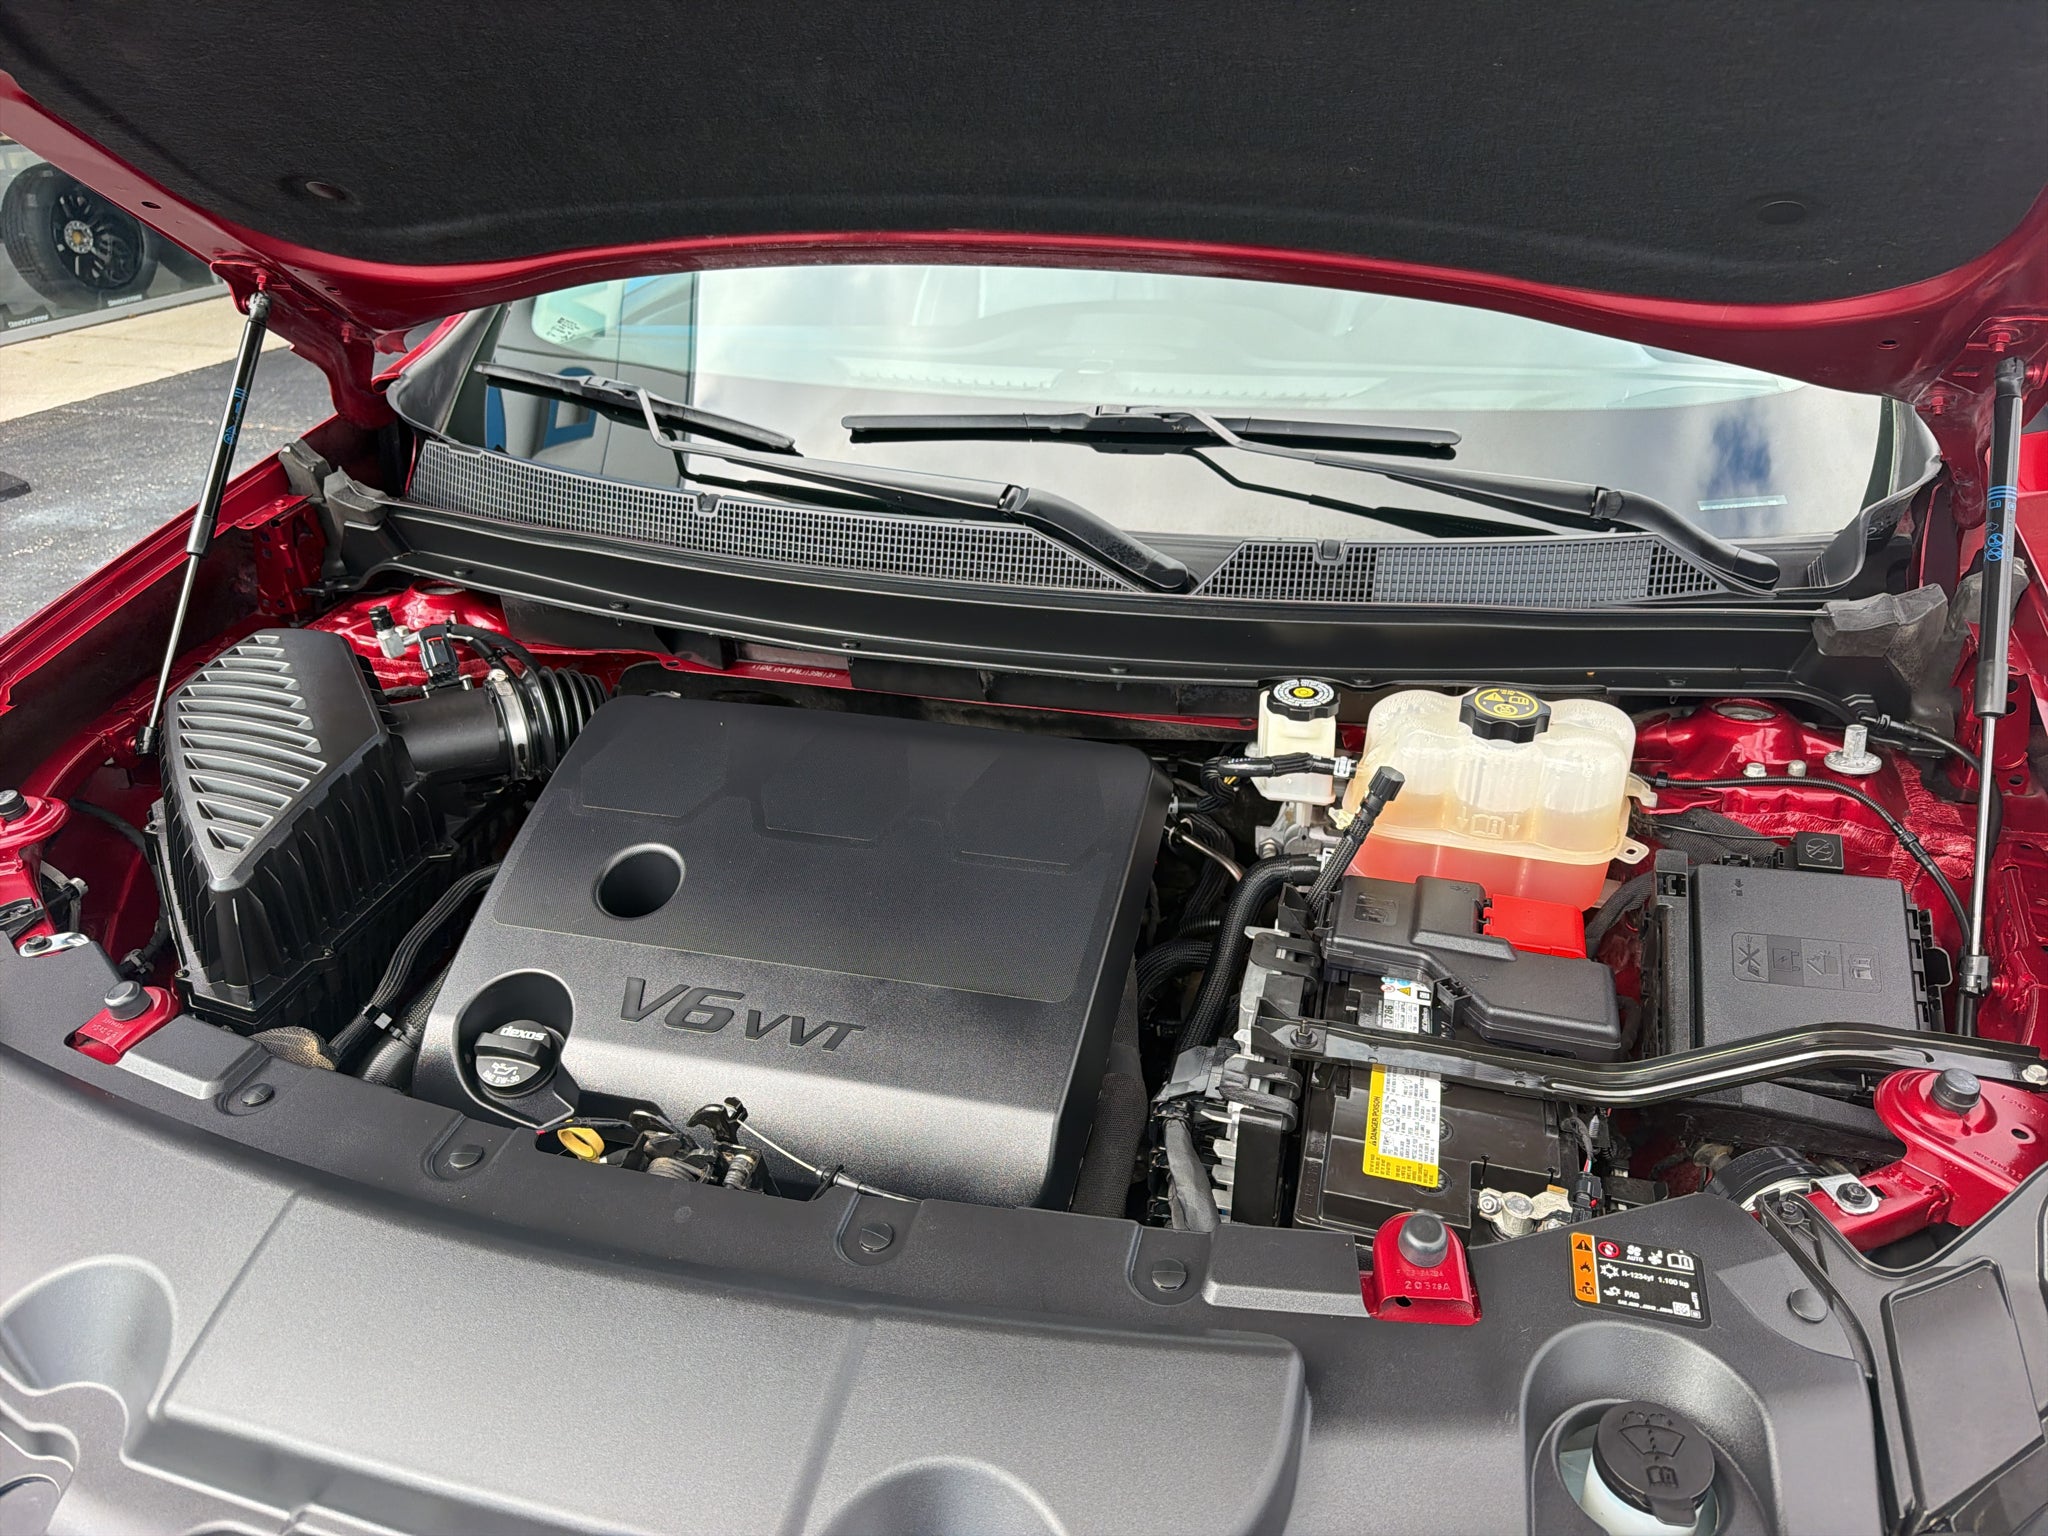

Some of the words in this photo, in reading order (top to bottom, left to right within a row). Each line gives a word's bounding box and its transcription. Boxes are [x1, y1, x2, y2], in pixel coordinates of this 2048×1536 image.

[619, 976, 744, 1033] V6
[745, 1009, 866, 1052] VVT
[1384, 1004, 1394, 1024] 3786
[500, 1025, 548, 1041] dexos
[482, 1070, 496, 1082] SAE
[495, 1075, 520, 1084] 5W-30
[1626, 1255, 1644, 1263] AUTO
[1624, 1290, 1640, 1300] PAG
